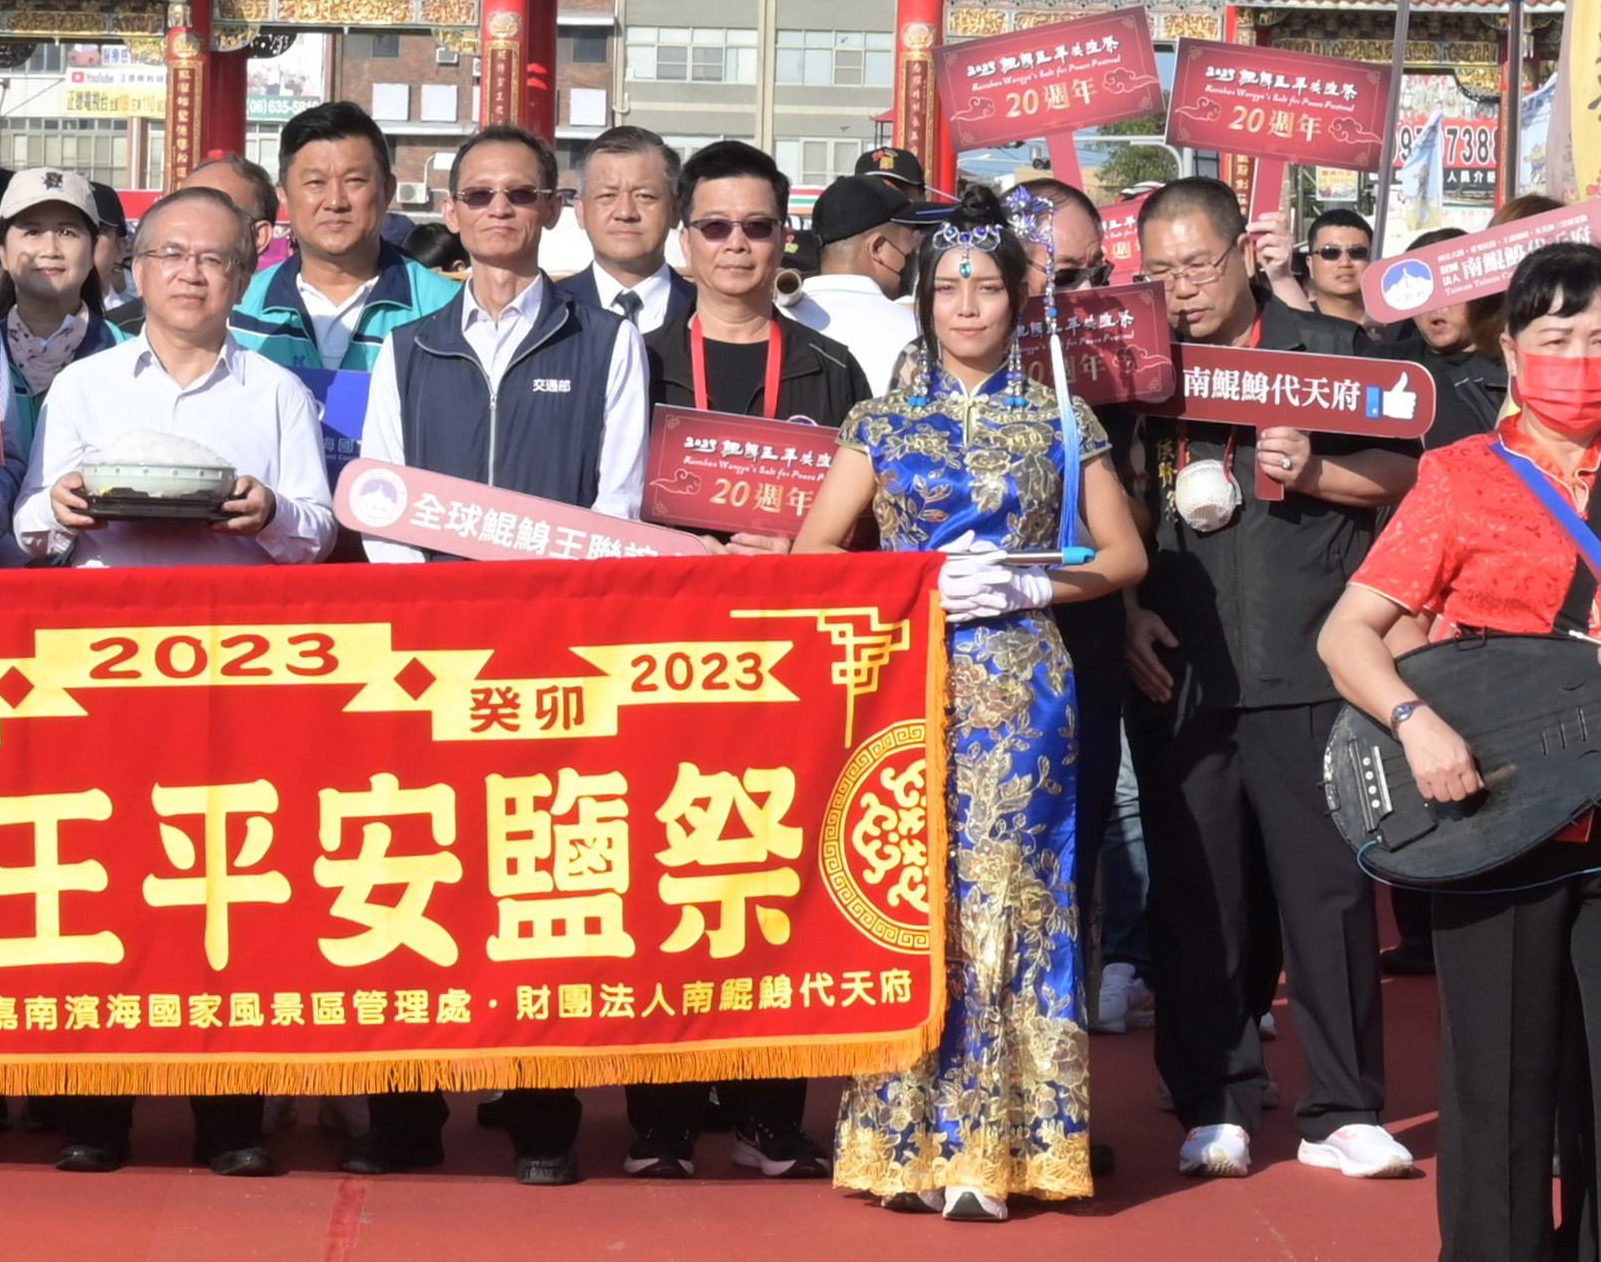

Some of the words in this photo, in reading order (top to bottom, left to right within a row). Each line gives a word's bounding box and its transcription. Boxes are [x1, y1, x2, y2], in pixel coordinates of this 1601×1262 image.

[533, 378, 572, 393] 交通部
[1183, 366, 1361, 412] 南鯤鯓代天府
[759, 465, 776, 476] Salt
[777, 468, 790, 480] for
[791, 470, 816, 481] Peace
[709, 478, 814, 517] 20週年
[409, 492, 684, 559] 全球鯤鯓王聯
[87, 633, 341, 682] 2023
[630, 651, 765, 694] 2023
[469, 683, 586, 734] 癸卯
